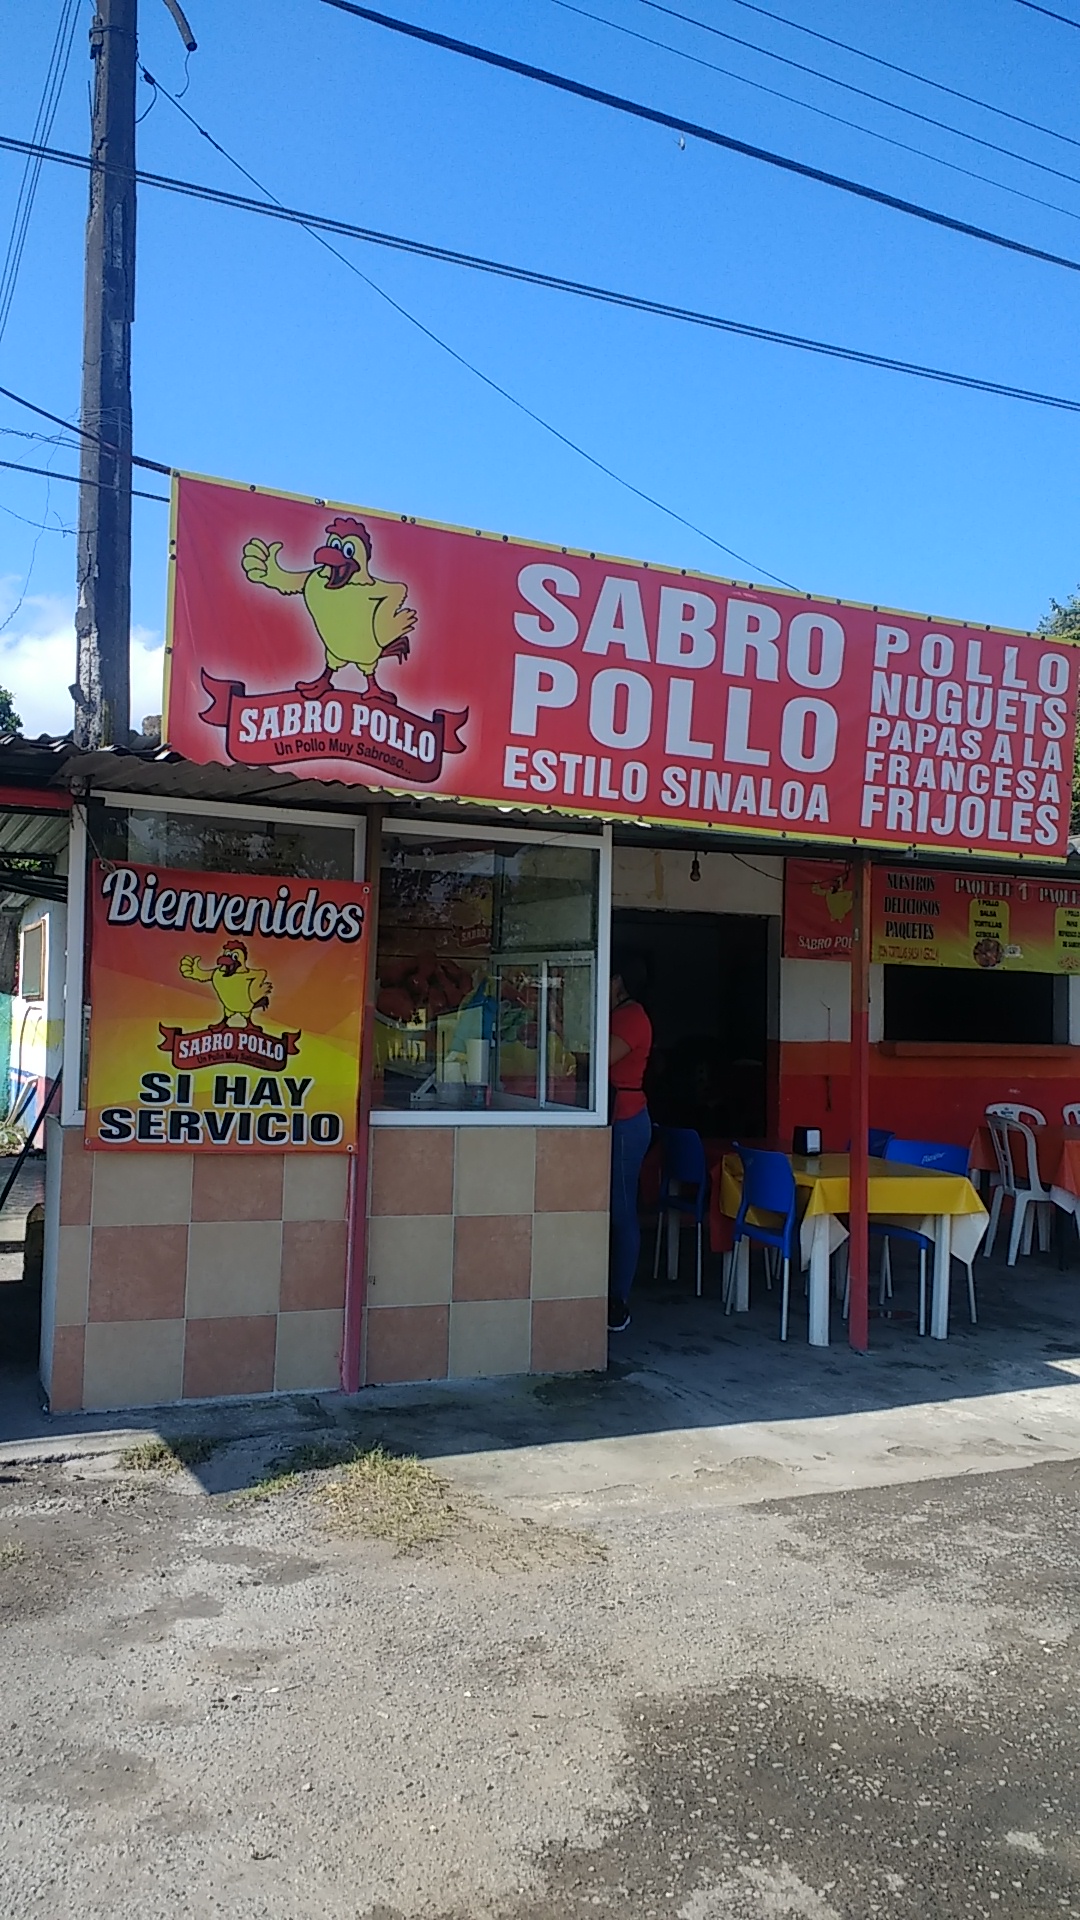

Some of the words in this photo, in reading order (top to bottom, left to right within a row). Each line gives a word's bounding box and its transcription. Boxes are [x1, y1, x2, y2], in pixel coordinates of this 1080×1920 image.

[513, 563, 845, 690] SABRO
[873, 624, 1070, 695] POLLO
[510, 653, 839, 773] POLLO
[870, 670, 1067, 738] NUGUETS
[238, 699, 342, 744] SABRO
[351, 702, 436, 763] POLLO
[274, 742, 293, 756] Un
[295, 738, 326, 753] Pollo
[329, 738, 354, 757] Muy
[867, 716, 983, 760] PAPAS
[991, 734, 1013, 765] A
[1023, 738, 1063, 771] LA
[503, 745, 648, 803] ESTILO
[660, 766, 830, 823] SINALOA
[864, 750, 1061, 804] FRANCESA
[860, 785, 1060, 846] FRIJOLES
[887, 872, 936, 892] NUESTROS
[955, 878, 1012, 898] PAQUETE
[1039, 887, 1080, 907] PAQUE
[102, 868, 364, 939] Bienvenidos
[883, 896, 941, 916] DELICIOSOS
[885, 920, 935, 940] PAQUETES
[974, 920, 1002, 928] TORTILLAS
[798, 935, 833, 950] SABRO
[178, 1032, 233, 1059] SABRO
[238, 1032, 284, 1061] POLLO
[139, 1072, 192, 1105] SI
[214, 1075, 313, 1107] HAY
[99, 1108, 341, 1143] SERVICIO
